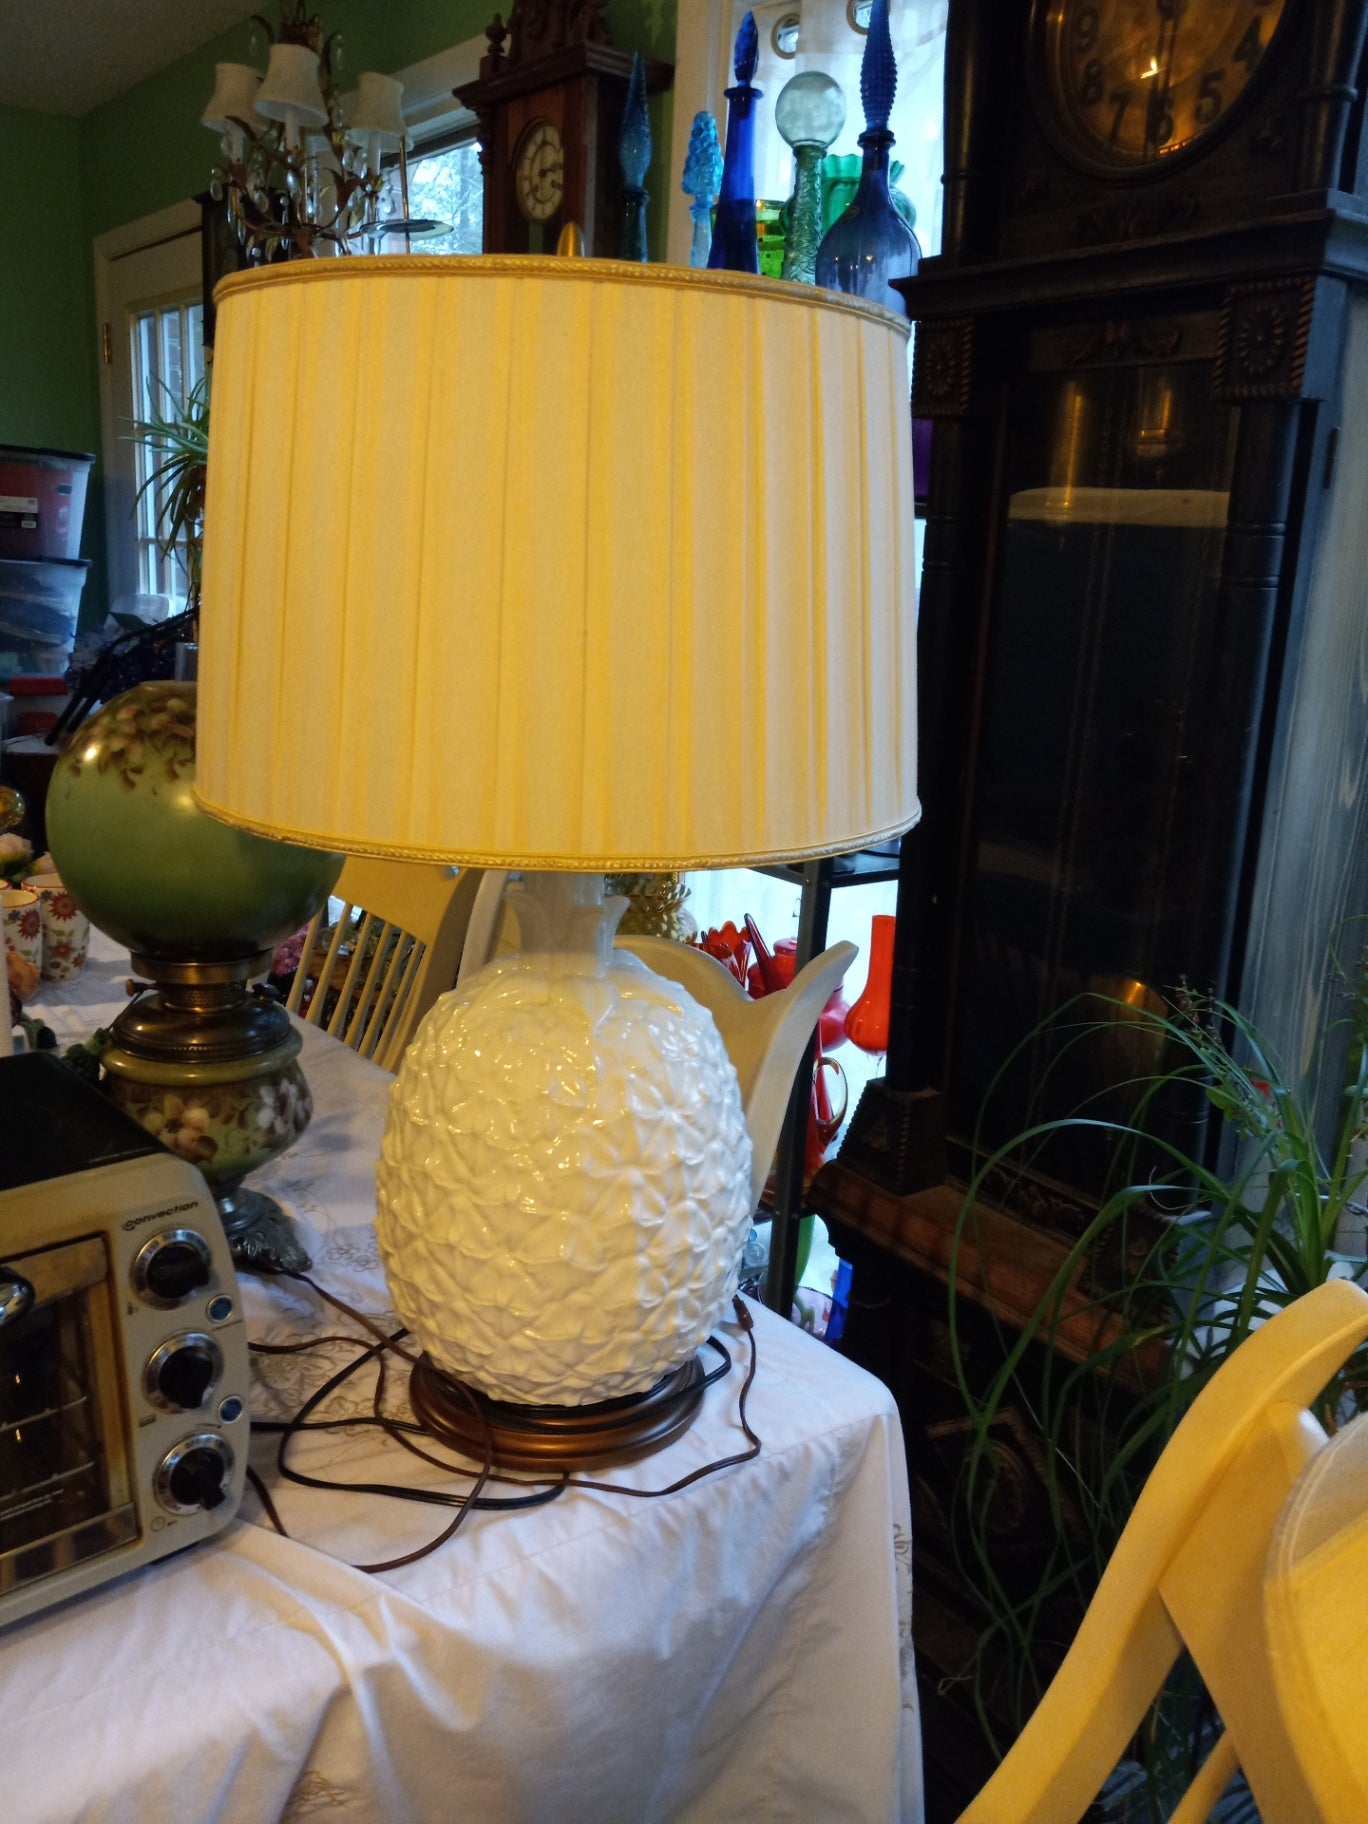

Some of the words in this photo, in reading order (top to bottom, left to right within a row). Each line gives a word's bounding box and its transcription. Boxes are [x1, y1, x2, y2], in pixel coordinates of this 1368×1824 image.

[1075, 6, 1099, 52] 9
[1233, 14, 1267, 76] 4
[1081, 57, 1103, 108] 8
[1196, 70, 1224, 124] 5
[1109, 88, 1134, 142] 7
